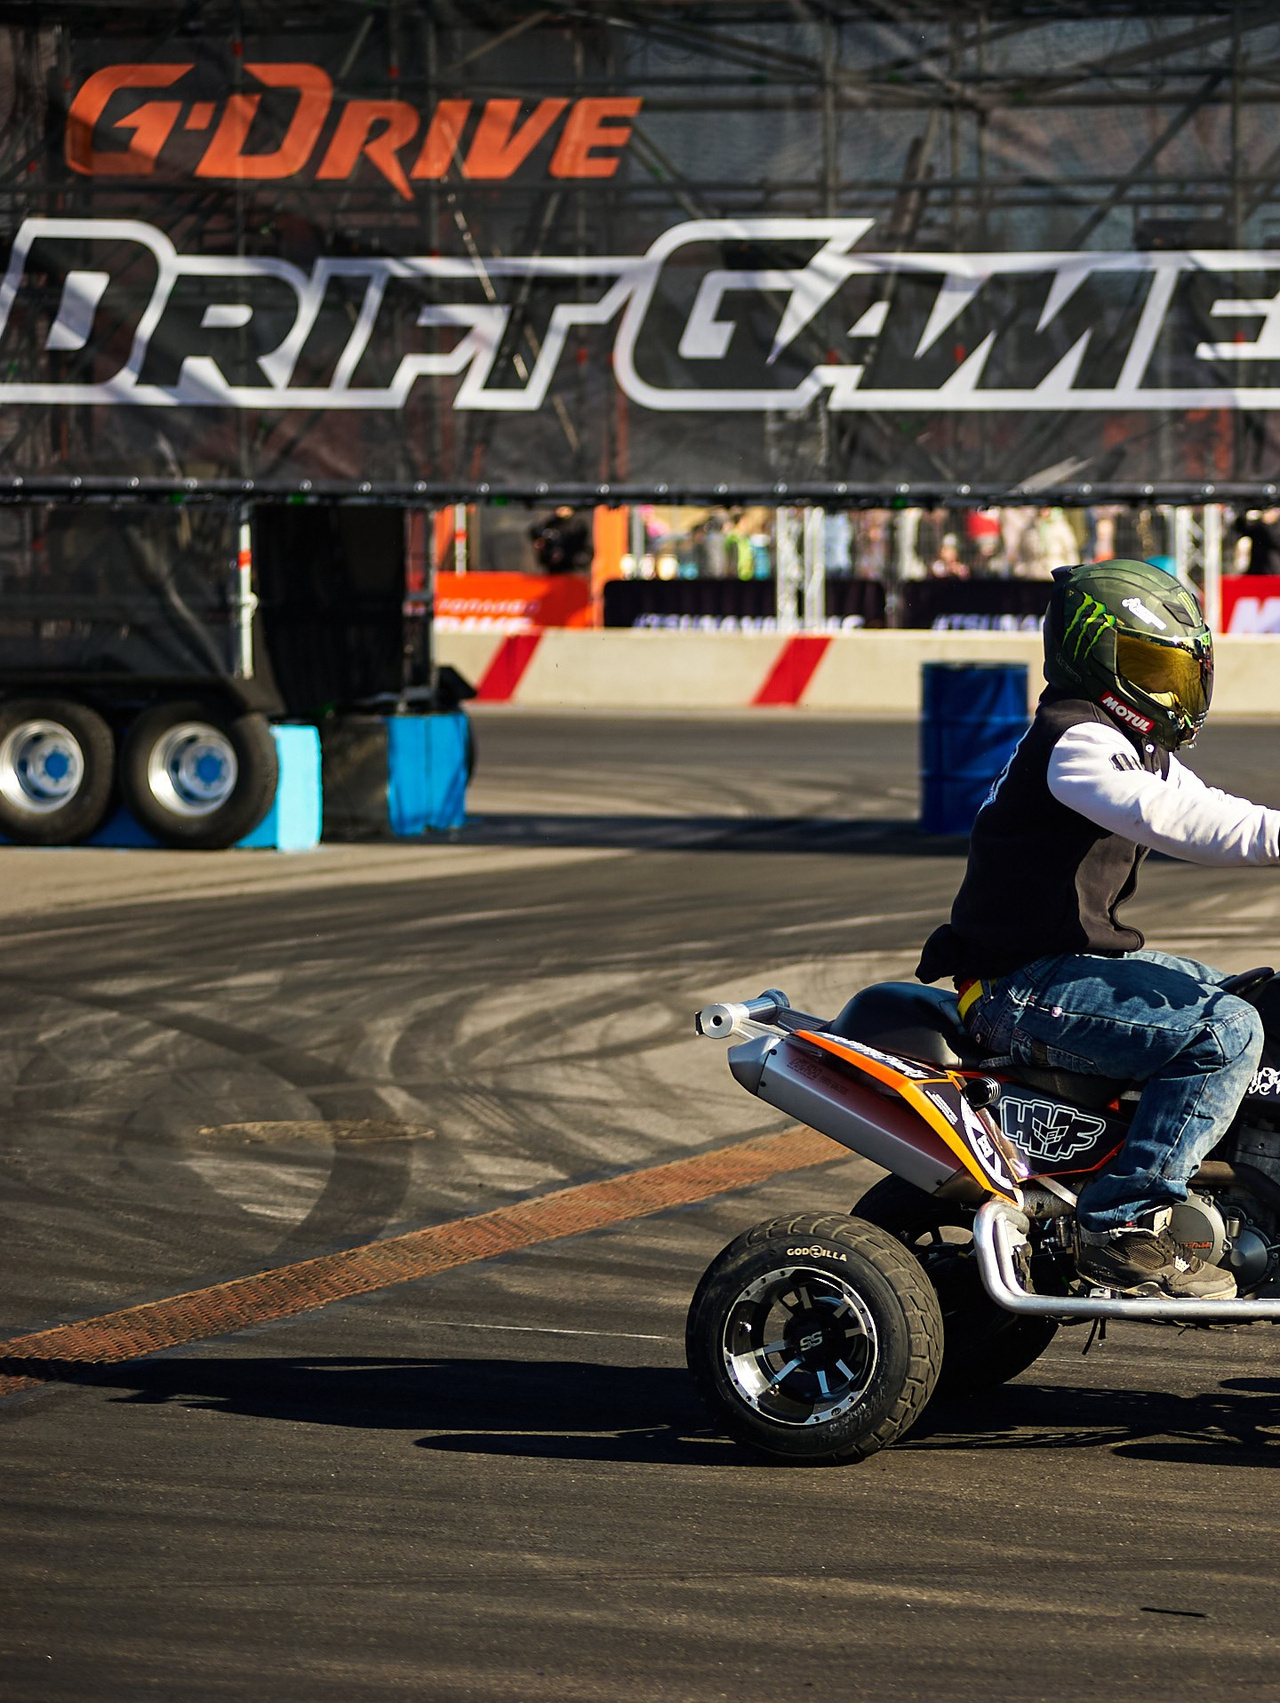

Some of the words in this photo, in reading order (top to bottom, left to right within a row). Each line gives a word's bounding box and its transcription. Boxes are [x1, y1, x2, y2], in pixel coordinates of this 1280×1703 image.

[66, 62, 643, 199] G-DRIVE
[0, 218, 640, 411] DRIFT
[1102, 696, 1150, 732] MOTUL
[786, 1244, 848, 1262] GODZILLA
